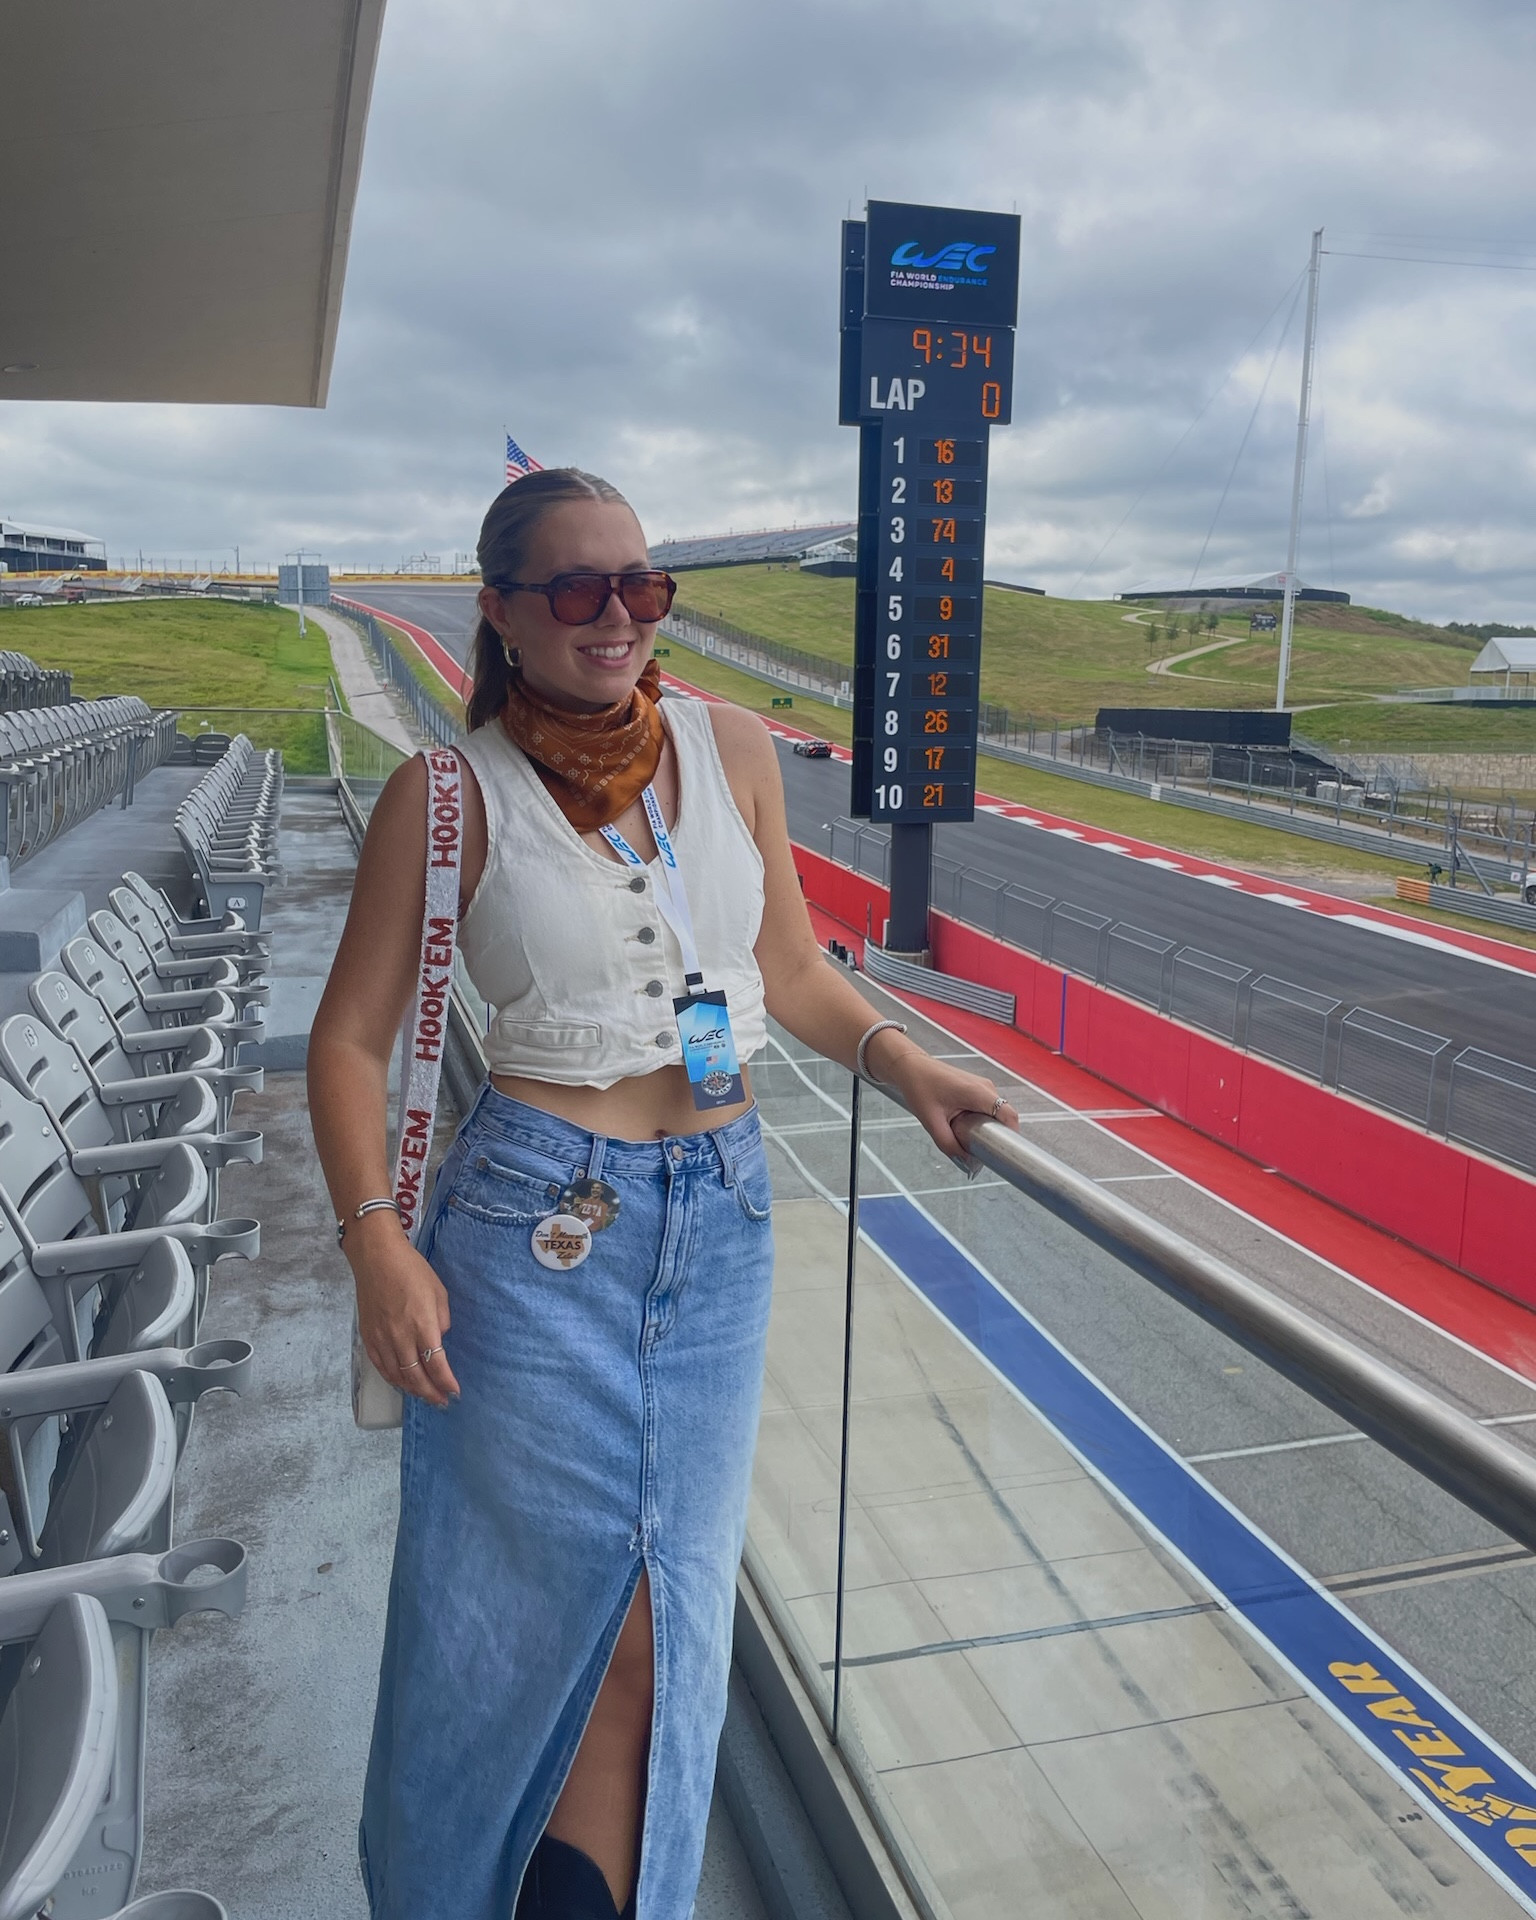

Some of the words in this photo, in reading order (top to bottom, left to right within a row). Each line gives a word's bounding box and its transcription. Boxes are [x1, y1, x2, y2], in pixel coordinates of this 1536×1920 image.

[891, 242, 997, 272] WEC
[890, 271, 904, 279] FIA
[906, 272, 936, 281] WORLD
[938, 275, 988, 286] ENDURANCE
[890, 279, 954, 290] CHAMPIONSHIP
[912, 328, 992, 369] 9:34
[870, 376, 926, 411] LAP
[981, 382, 1000, 418] 0
[893, 437, 904, 464] 1
[934, 440, 954, 464] 16
[891, 477, 906, 504] 2
[933, 480, 953, 504] 13
[890, 516, 905, 543] 3
[932, 519, 956, 543] 74
[889, 556, 903, 582] 4
[941, 557, 954, 582] 4
[888, 595, 903, 621] 5
[939, 597, 953, 621] 9
[886, 634, 901, 660] 6
[886, 672, 900, 697] 7
[927, 673, 947, 696] 12
[884, 710, 899, 736] 8
[924, 710, 948, 734] 26
[883, 747, 898, 773] 9
[924, 747, 945, 770] 17
[875, 784, 903, 810] 10
[923, 784, 944, 807] 21
[607, 834, 641, 864] WEC
[655, 832, 677, 868] WEC
[415, 917, 454, 1062] HOOK'EM
[688, 1028, 725, 1044] WEC
[395, 1109, 431, 1240] OOK'EM
[544, 1240, 581, 1250] TEXAS
